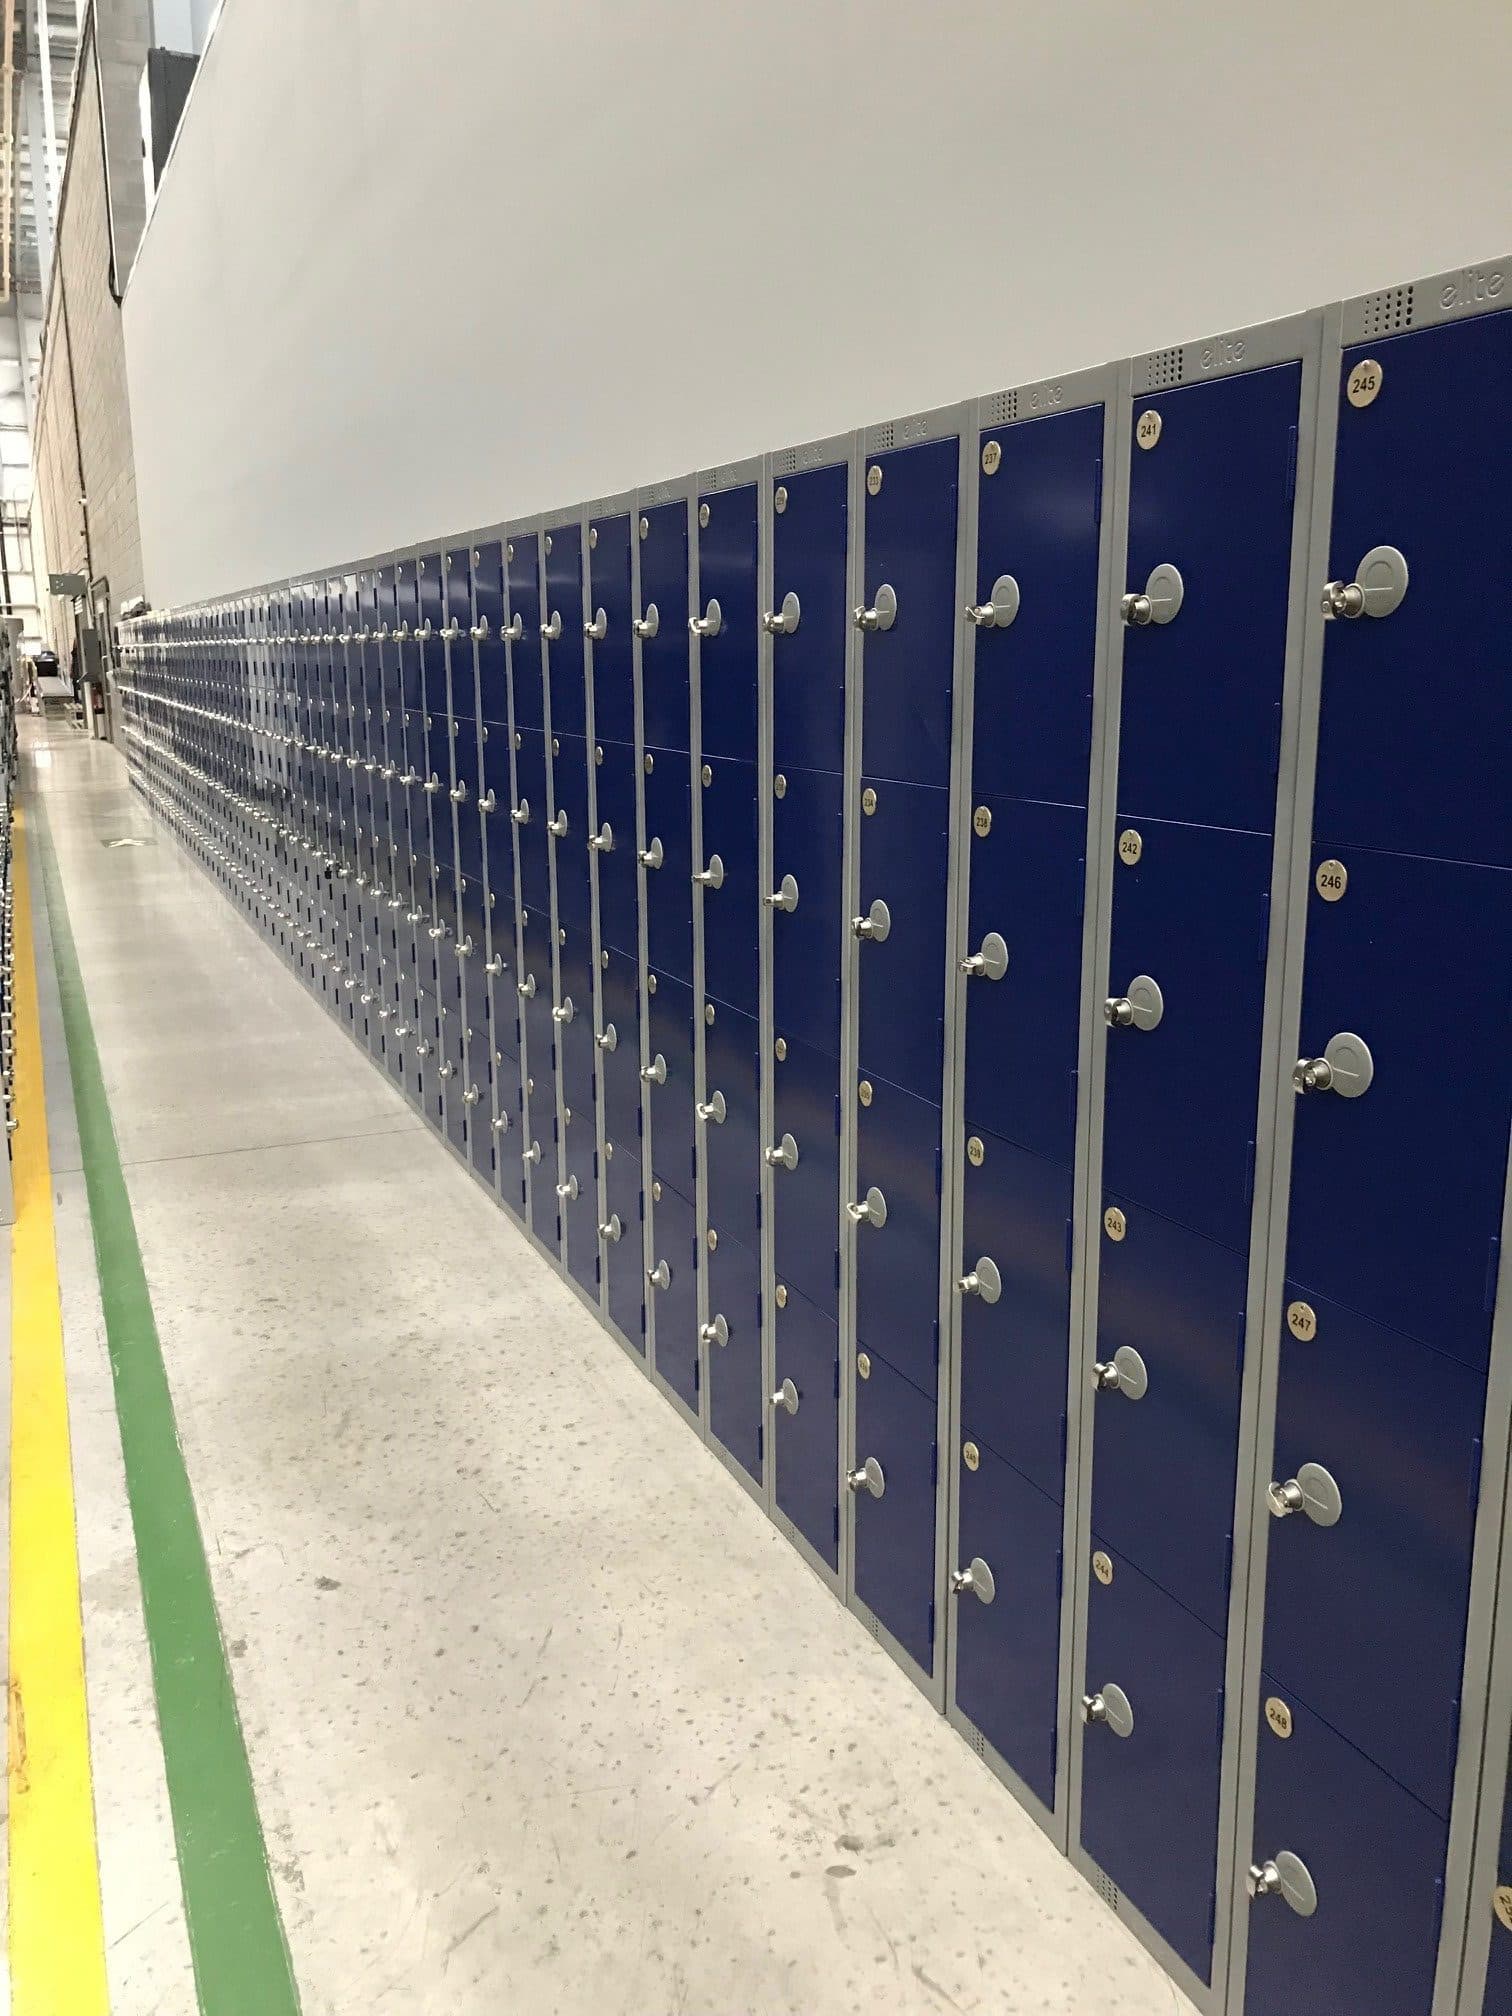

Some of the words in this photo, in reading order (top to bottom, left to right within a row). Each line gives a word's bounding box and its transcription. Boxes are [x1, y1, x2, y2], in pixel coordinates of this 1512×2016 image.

[1352, 375, 1376, 394] 245
[1141, 424, 1156, 438] 241
[984, 452, 997, 465] 237
[1122, 841, 1138, 855] 242
[1320, 874, 1342, 890] 246
[1107, 1217, 1122, 1233] 243
[1292, 1313, 1311, 1332] 247
[1270, 1707, 1288, 1730] 248
